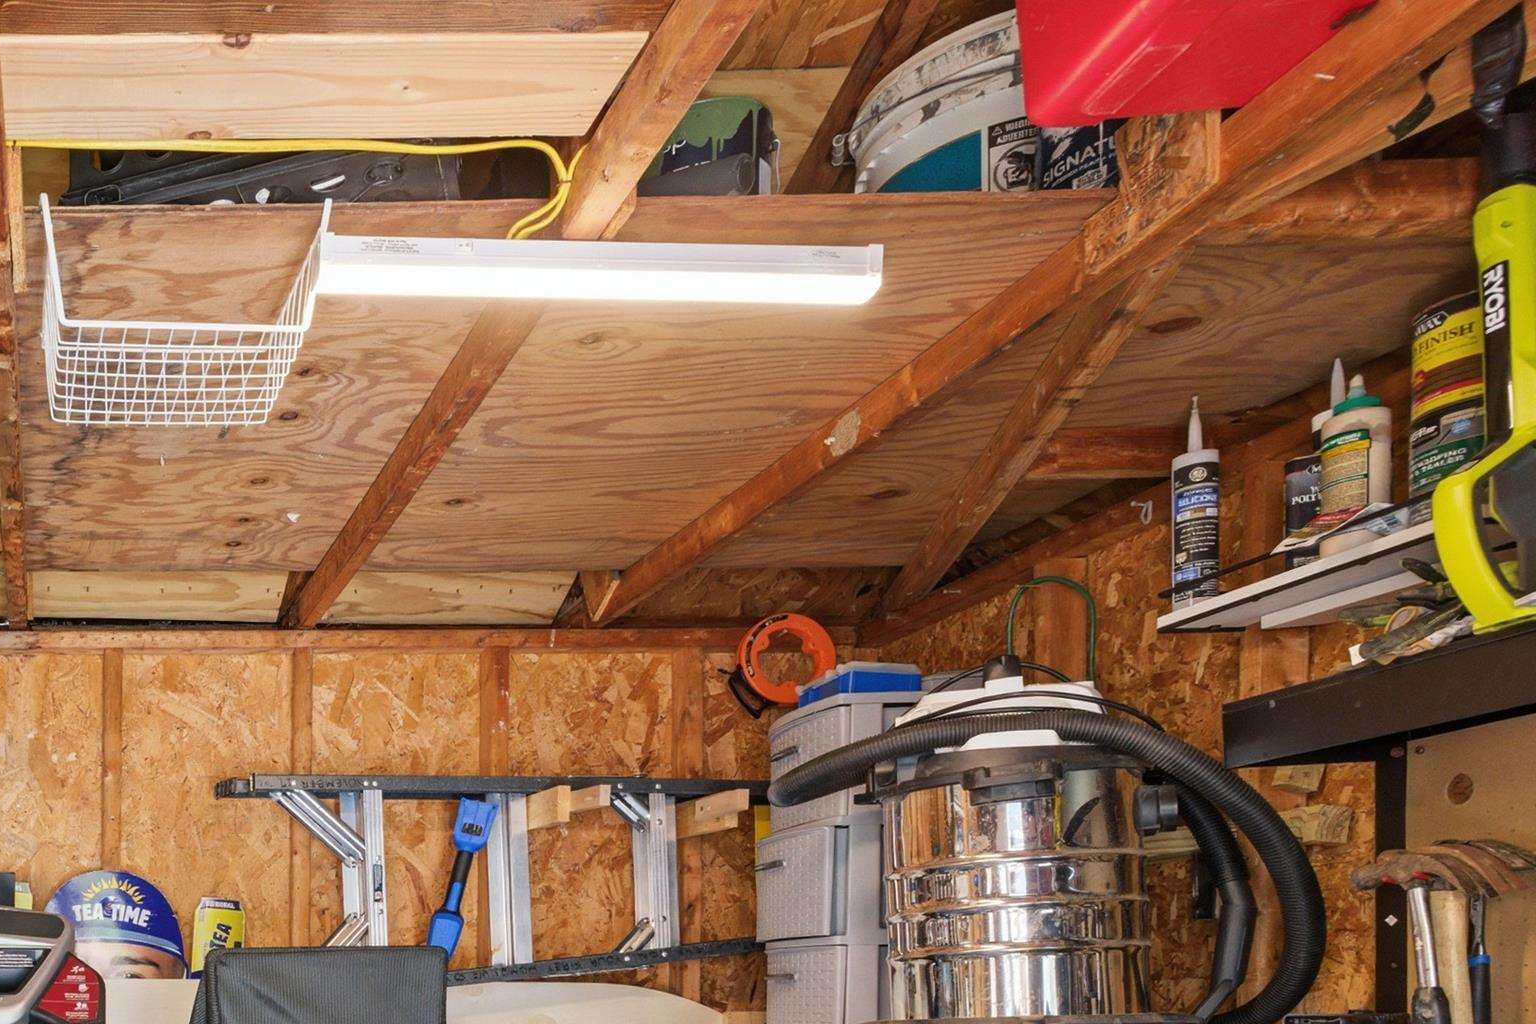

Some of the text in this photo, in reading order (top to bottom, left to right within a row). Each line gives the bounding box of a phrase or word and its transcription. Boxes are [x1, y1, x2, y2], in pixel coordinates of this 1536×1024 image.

[1483, 263, 1507, 335] RYOBI
[1418, 321, 1476, 354] FINISH
[72, 903, 152, 927] TEA TIME
